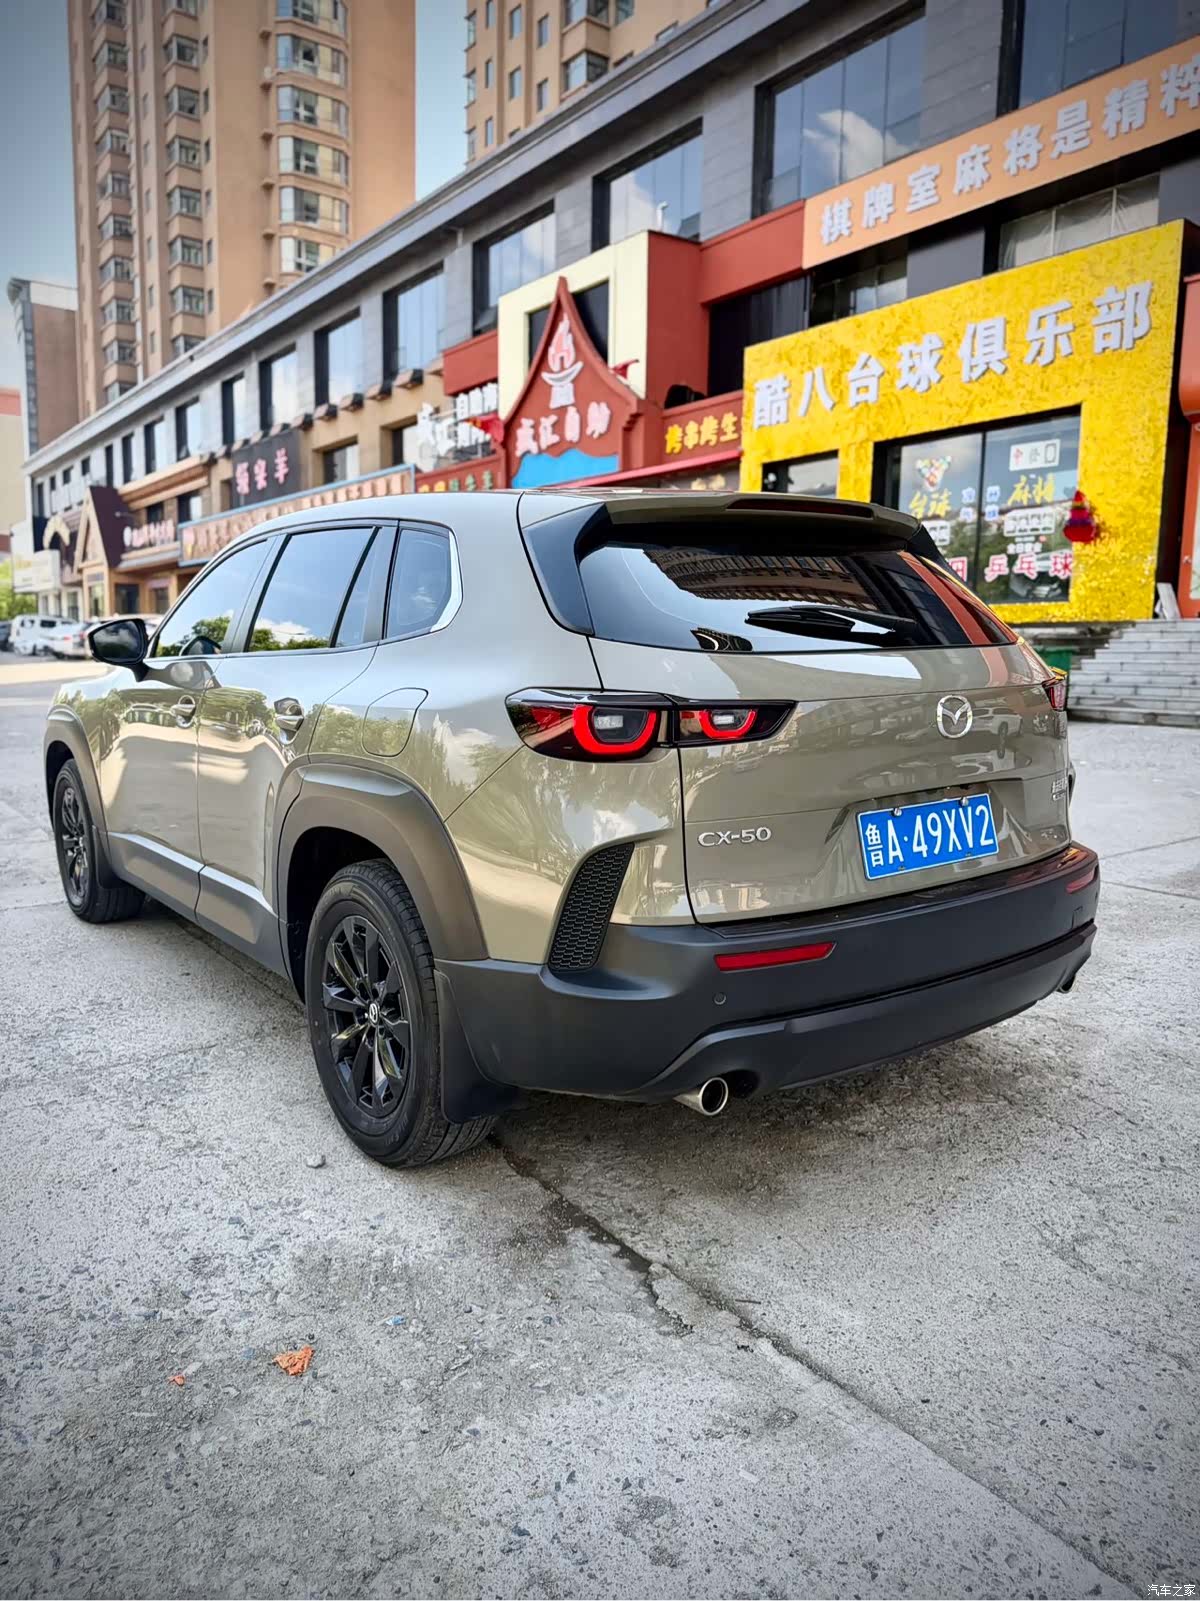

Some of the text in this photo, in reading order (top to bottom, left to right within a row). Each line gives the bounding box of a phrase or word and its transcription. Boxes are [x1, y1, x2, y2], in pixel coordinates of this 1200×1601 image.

[752, 280, 1154, 430] 酷八台球俱乐部
[908, 488, 952, 520] 台球
[1008, 473, 1055, 506] 麻将
[984, 551, 1073, 582] 乒乓球
[697, 825, 772, 848] CX-50
